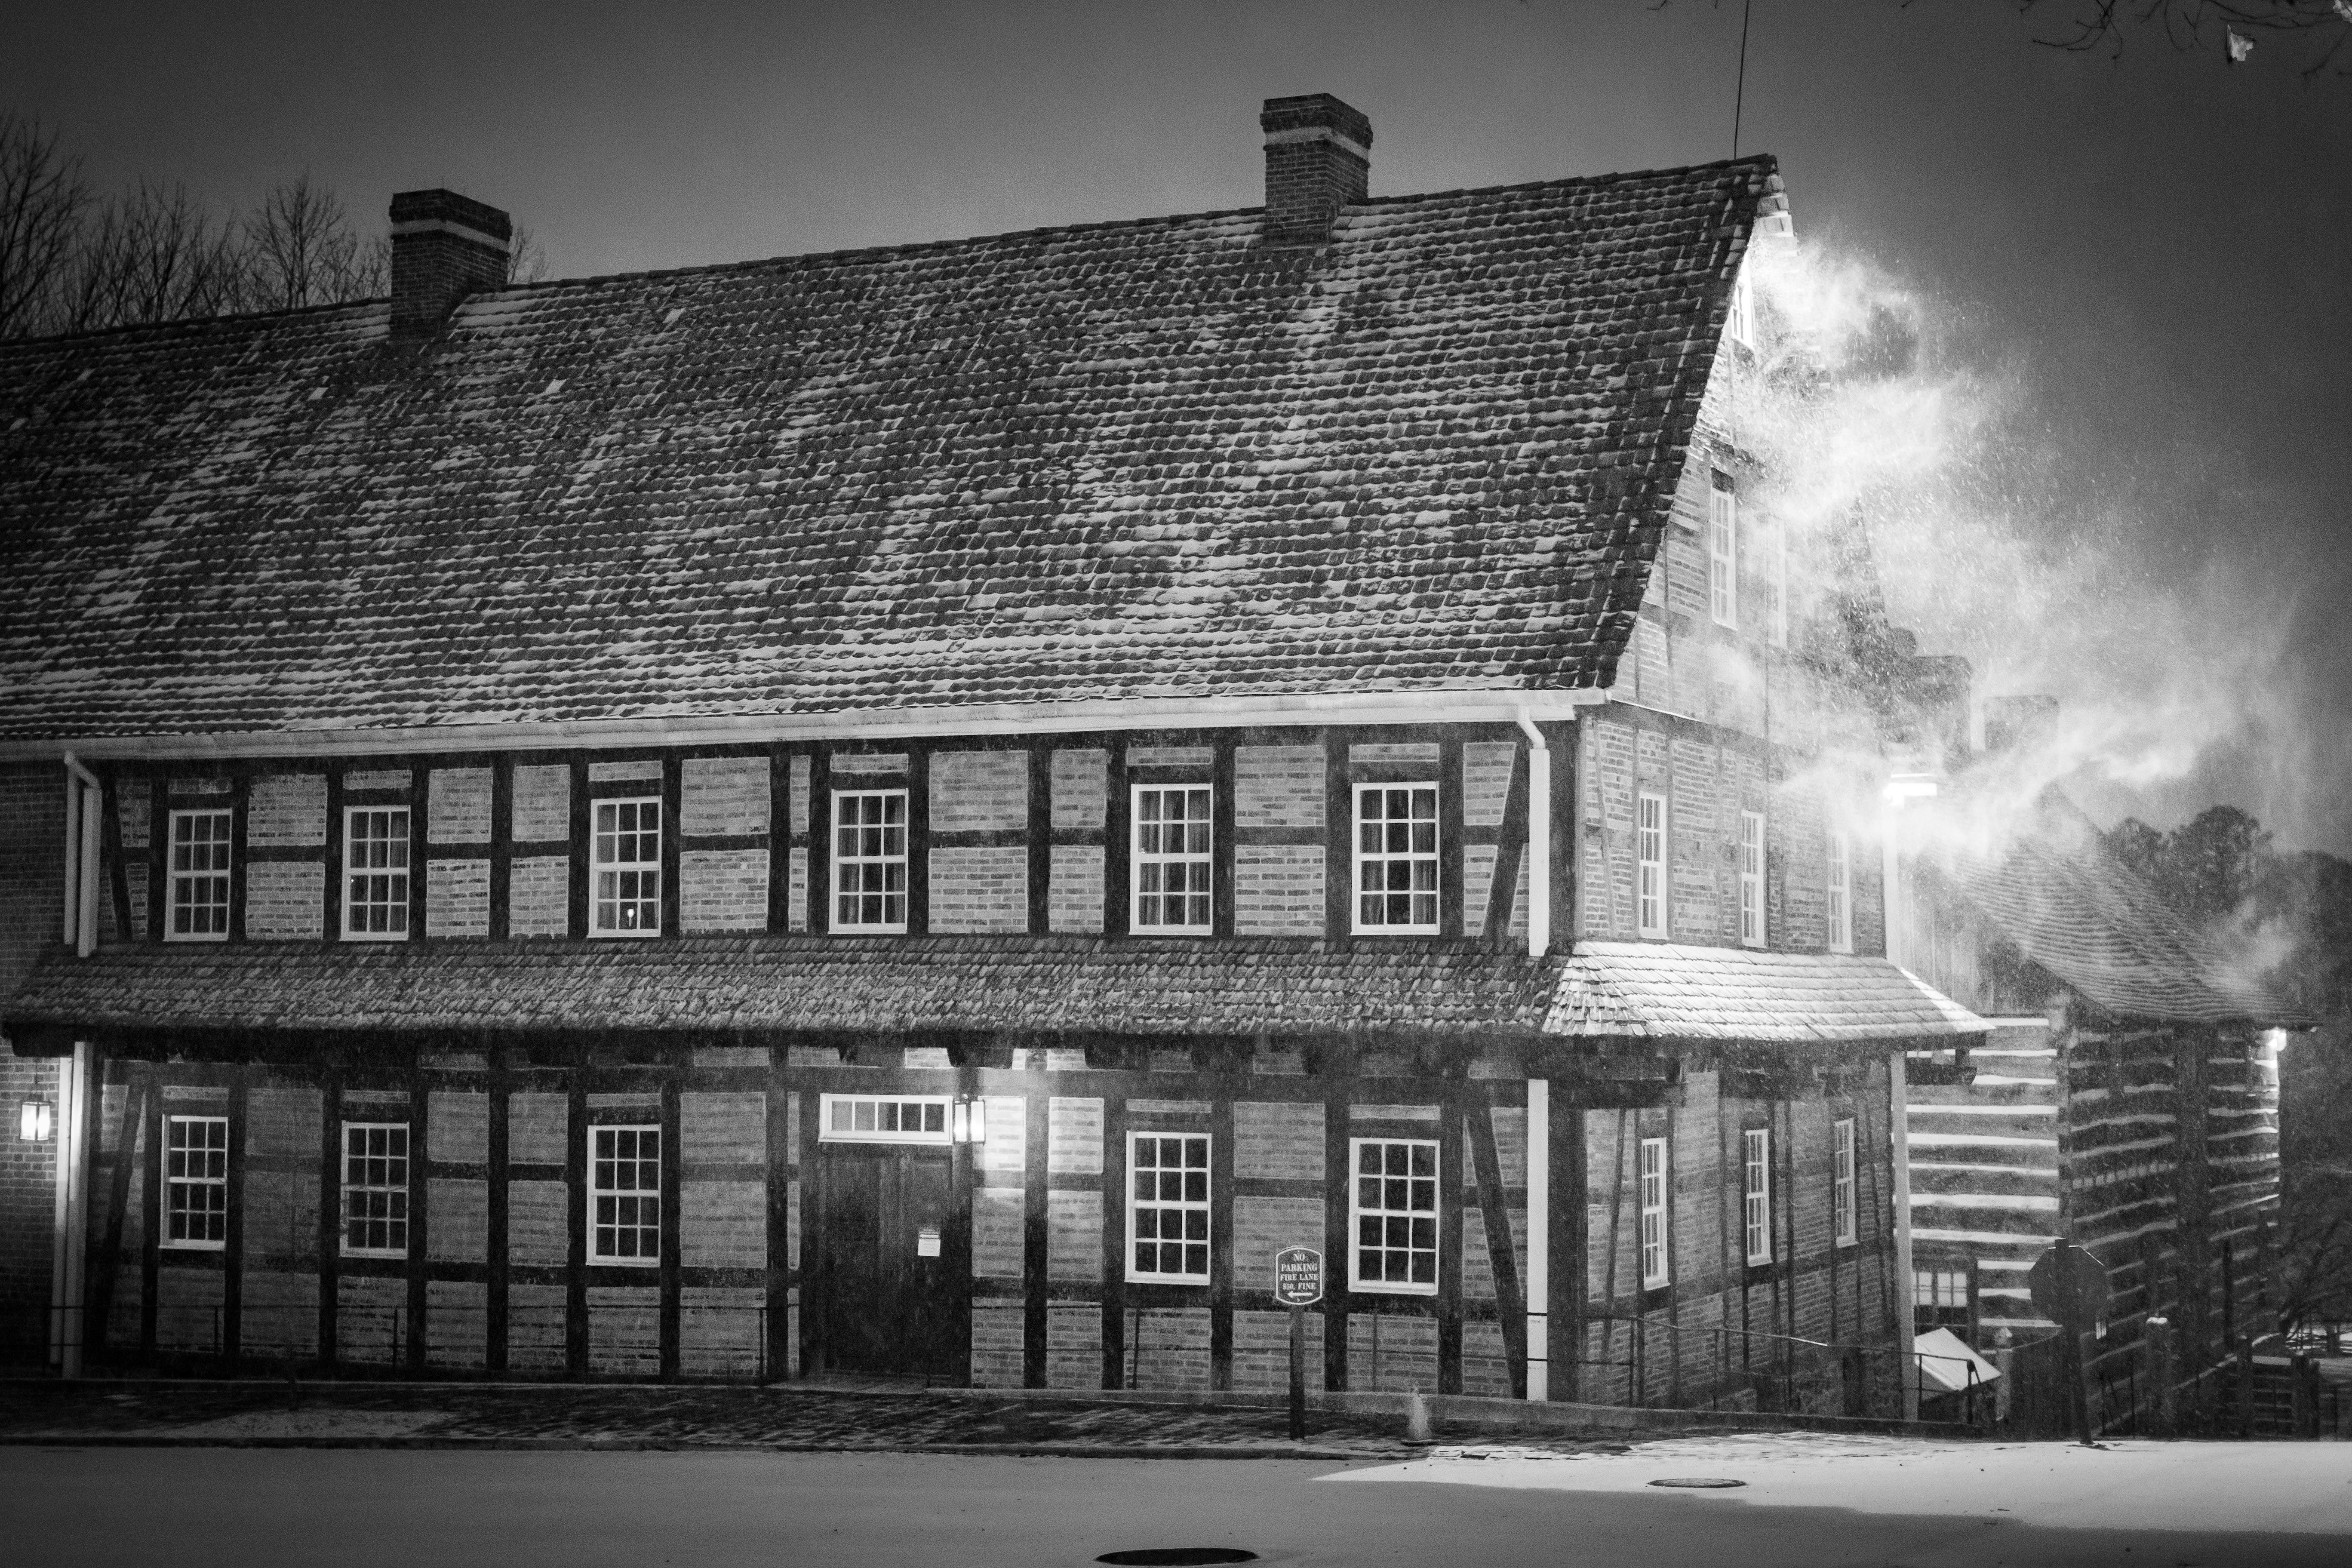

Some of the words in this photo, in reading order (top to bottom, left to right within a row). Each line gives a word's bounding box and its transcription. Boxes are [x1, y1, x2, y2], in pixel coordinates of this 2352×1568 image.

[1293, 1253, 1305, 1261] NO
[1281, 1263, 1317, 1272] PARKING
[1298, 1282, 1316, 1290] FINE
